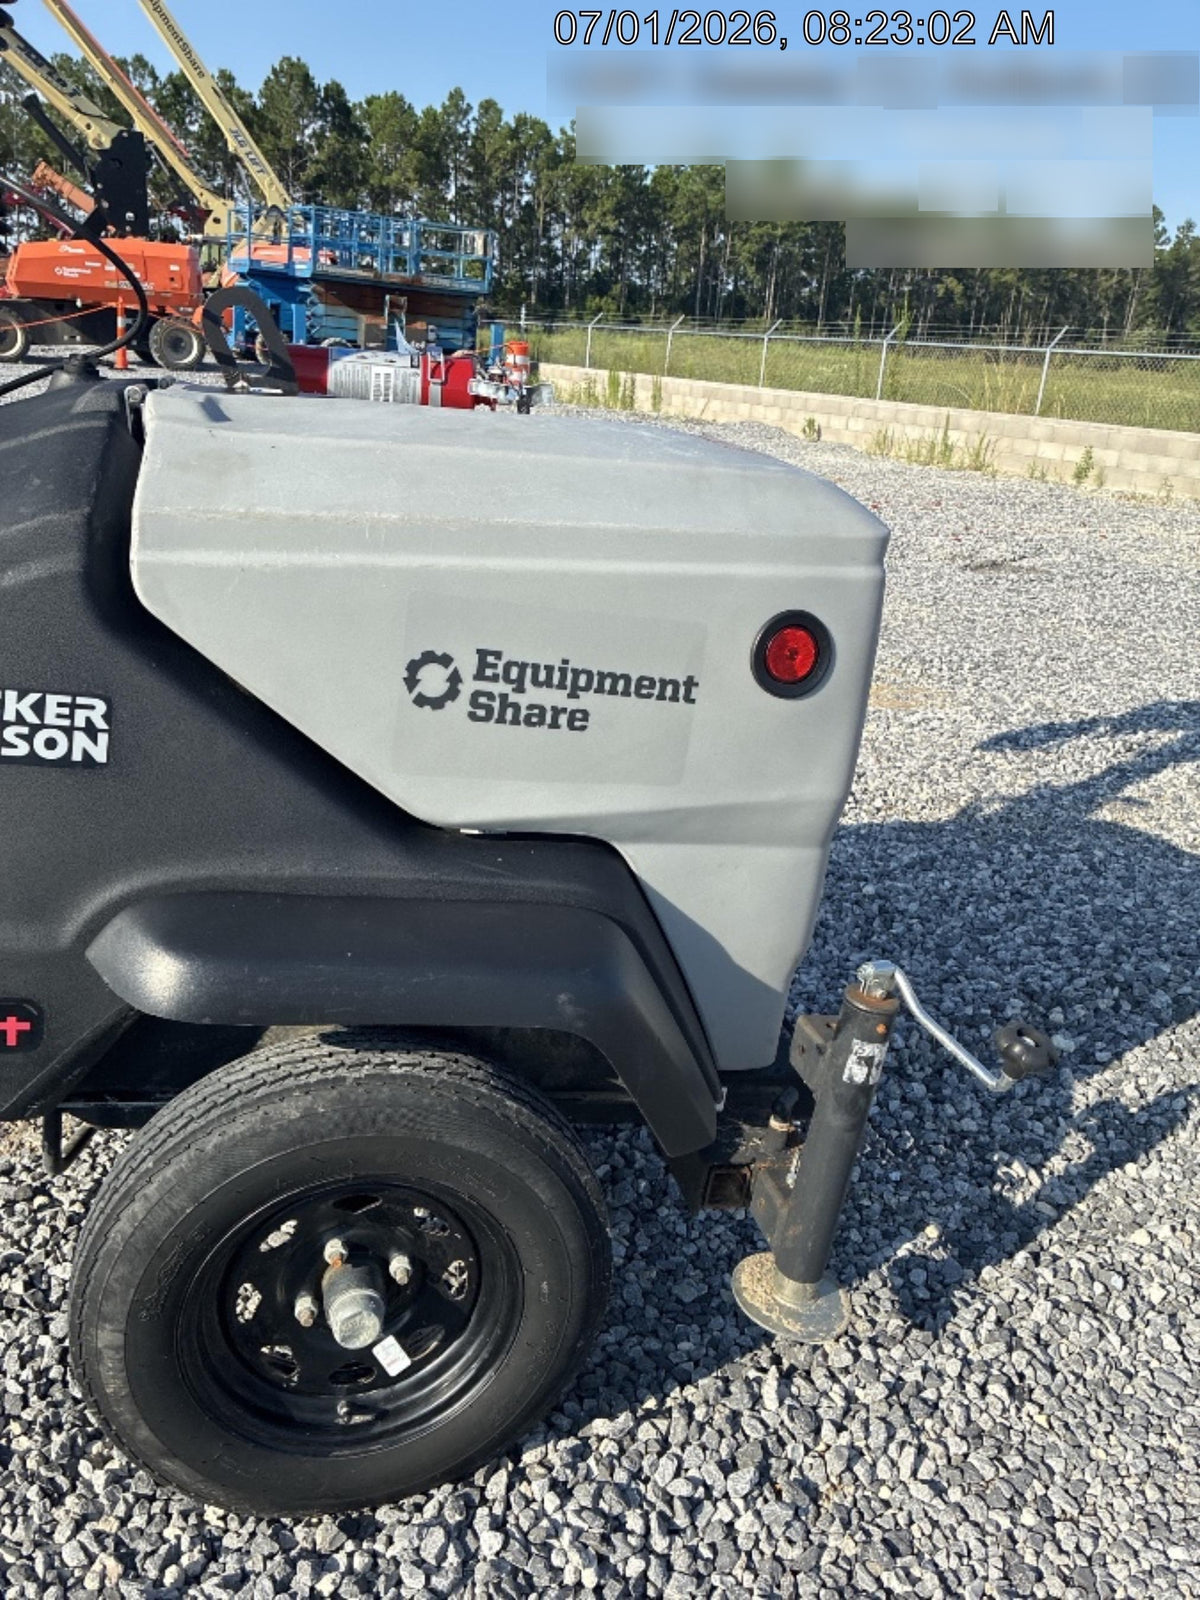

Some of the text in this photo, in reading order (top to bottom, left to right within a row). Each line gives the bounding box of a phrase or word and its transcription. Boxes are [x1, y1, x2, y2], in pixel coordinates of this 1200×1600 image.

[472, 648, 699, 704] Equipment
[0, 689, 110, 730] KER
[467, 690, 590, 731] Share
[0, 725, 109, 763] SON
